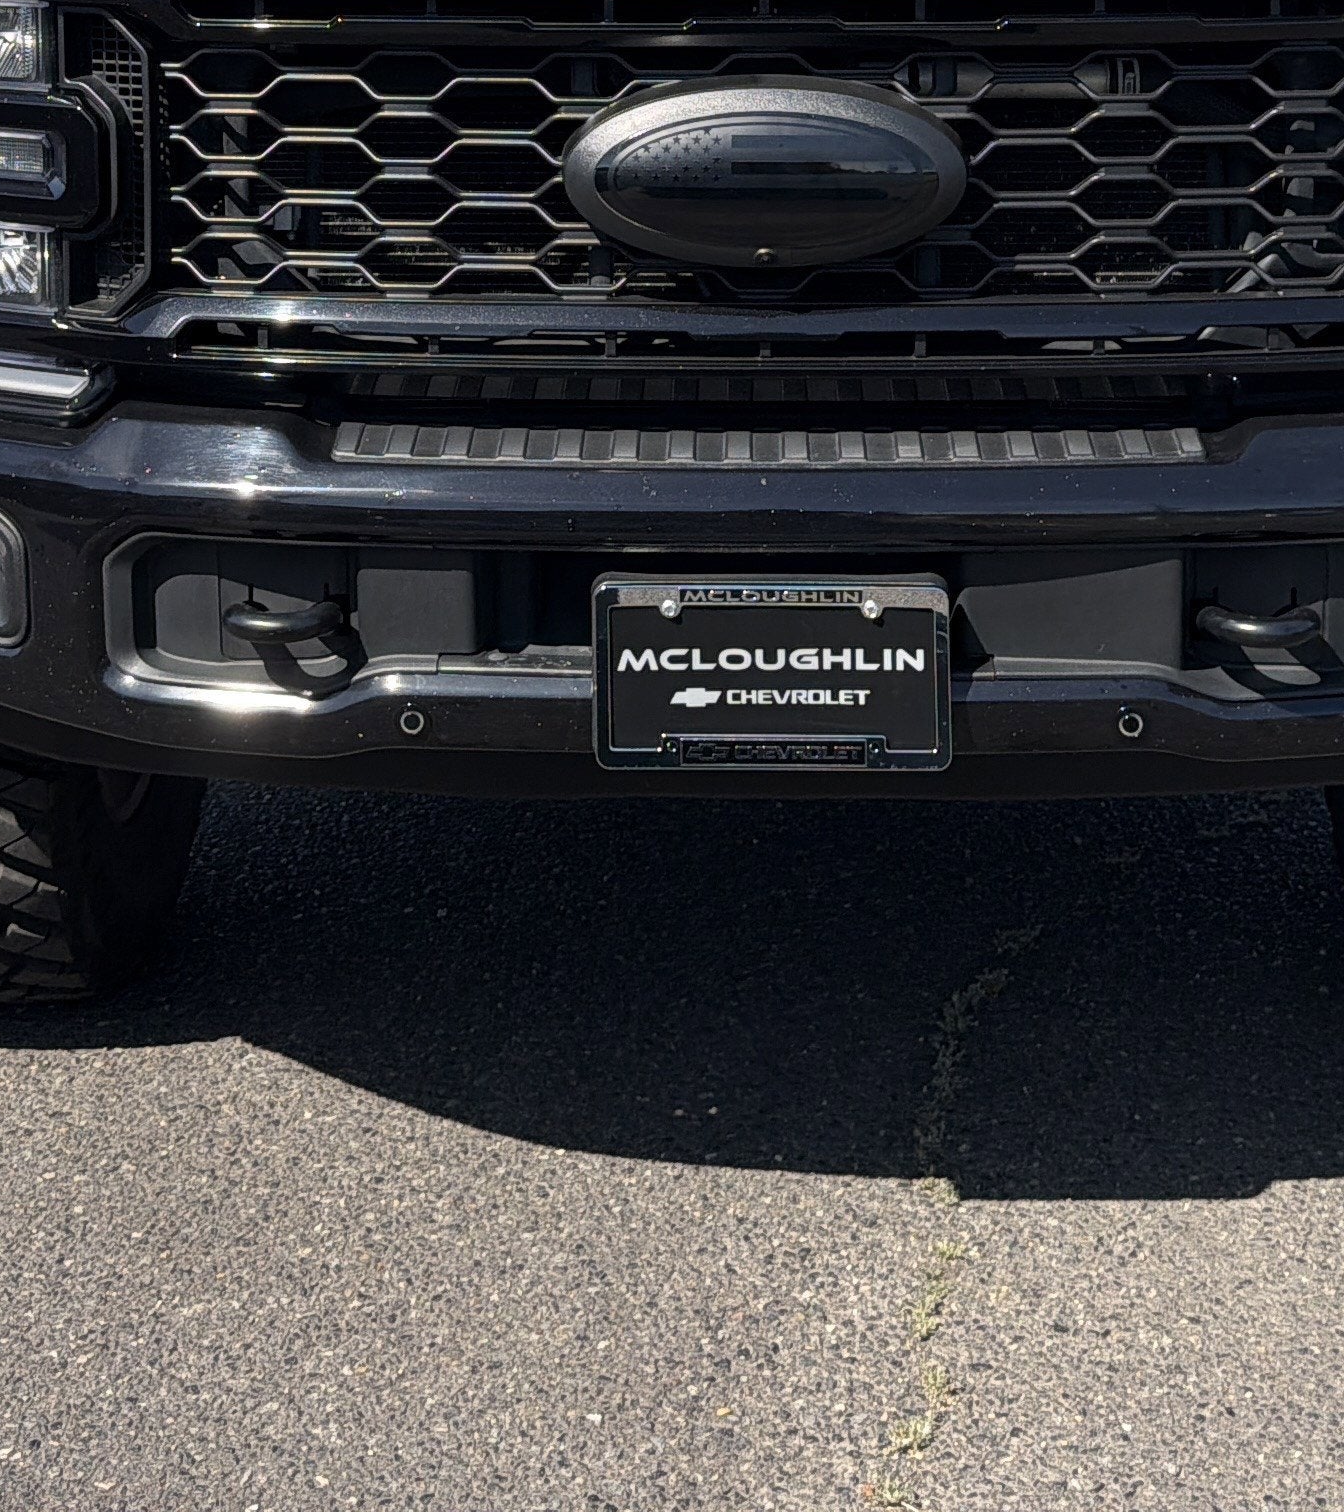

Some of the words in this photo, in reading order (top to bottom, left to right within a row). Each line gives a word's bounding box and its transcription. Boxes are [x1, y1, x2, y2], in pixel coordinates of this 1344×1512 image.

[682, 589, 860, 604] MCLOUGHLIN
[617, 648, 925, 672] MCLOUGHLIN
[726, 689, 871, 706] CHEVROLET
[734, 745, 863, 761] CHEVROLET
